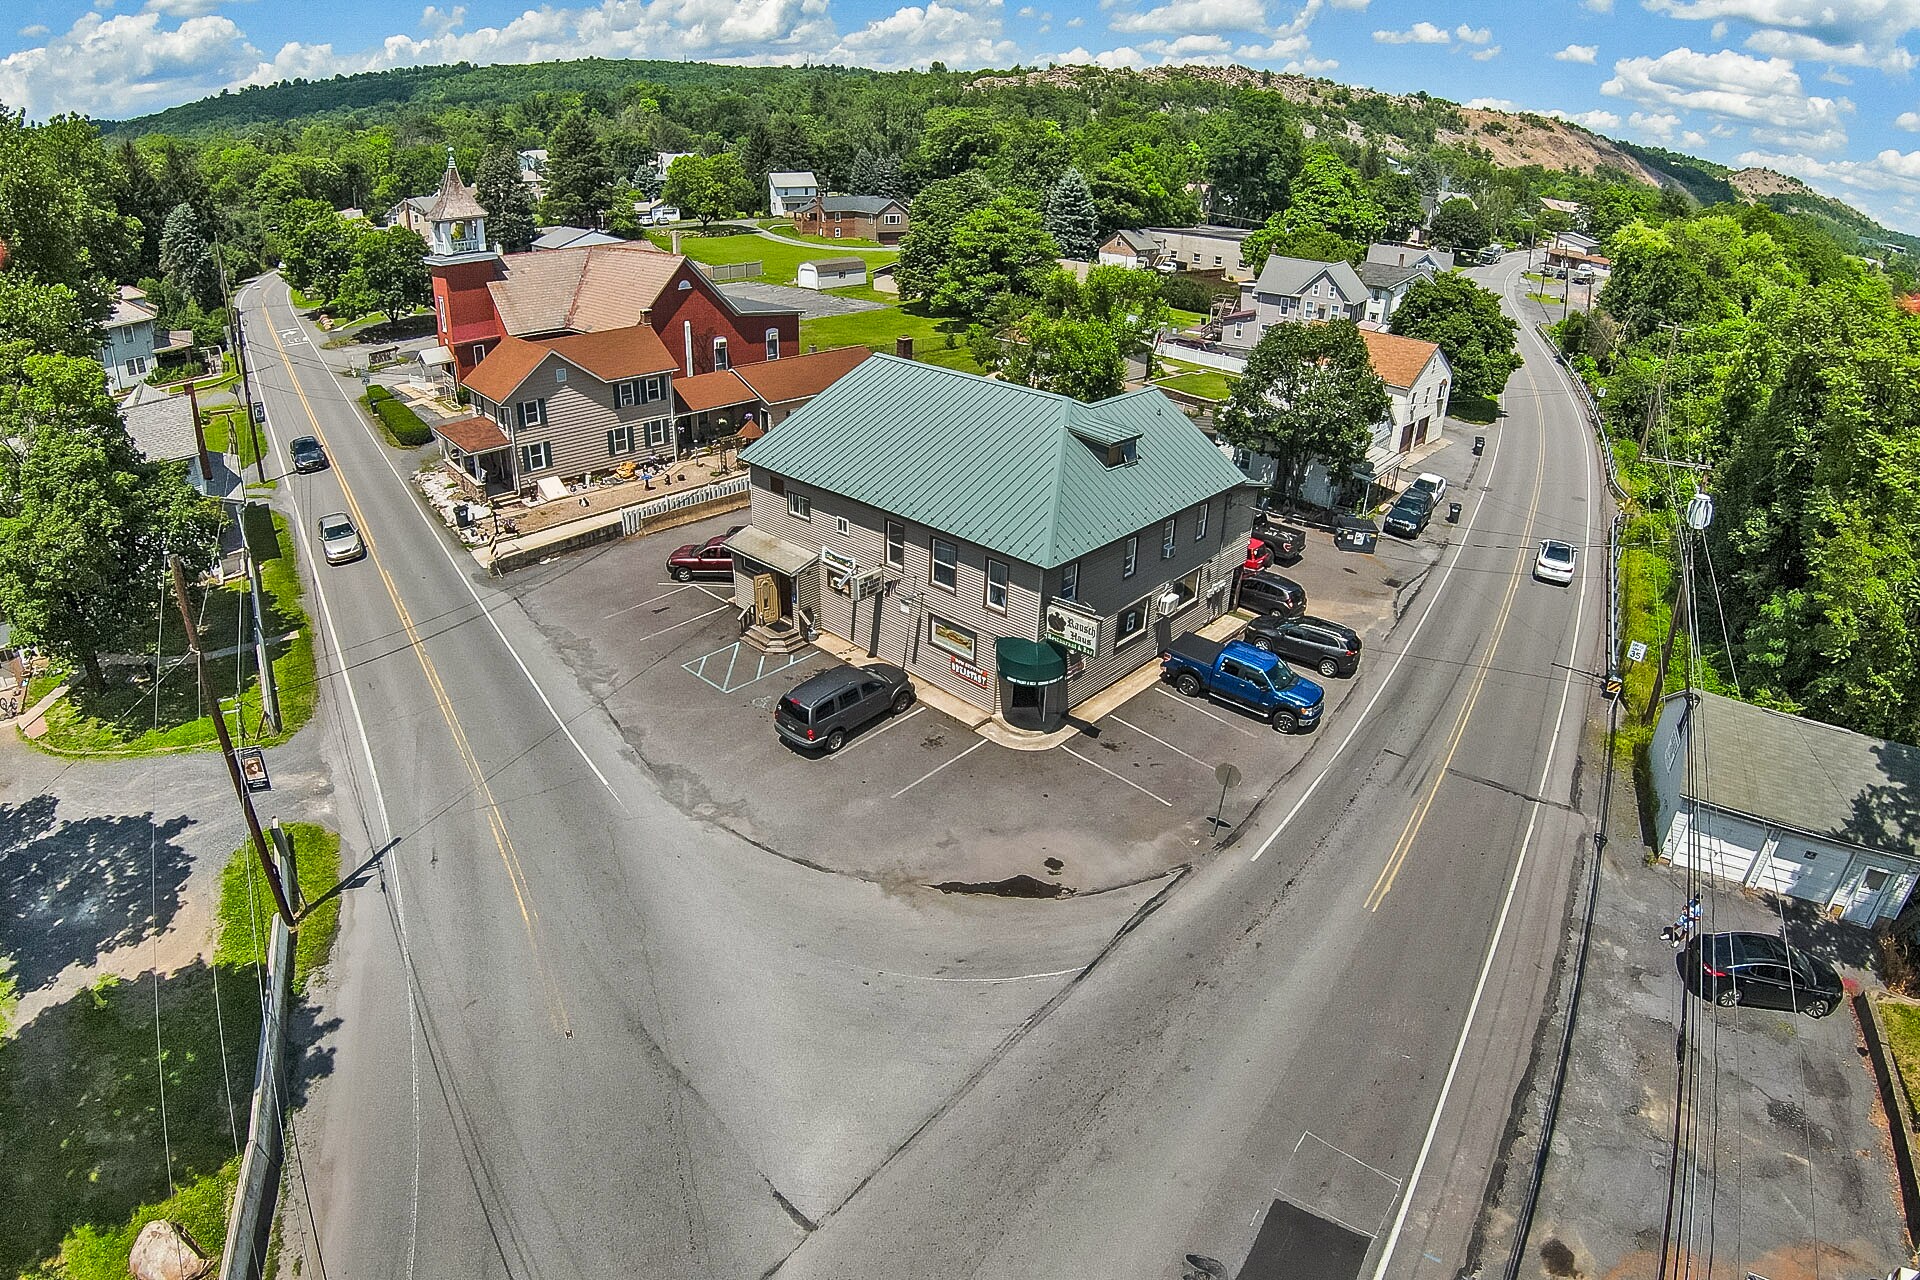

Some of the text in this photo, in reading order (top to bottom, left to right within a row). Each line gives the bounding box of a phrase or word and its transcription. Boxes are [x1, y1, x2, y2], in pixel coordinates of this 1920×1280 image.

[1067, 617, 1095, 638] Rausch
[1070, 630, 1092, 646] Haus
[1630, 650, 1640, 659] 35
